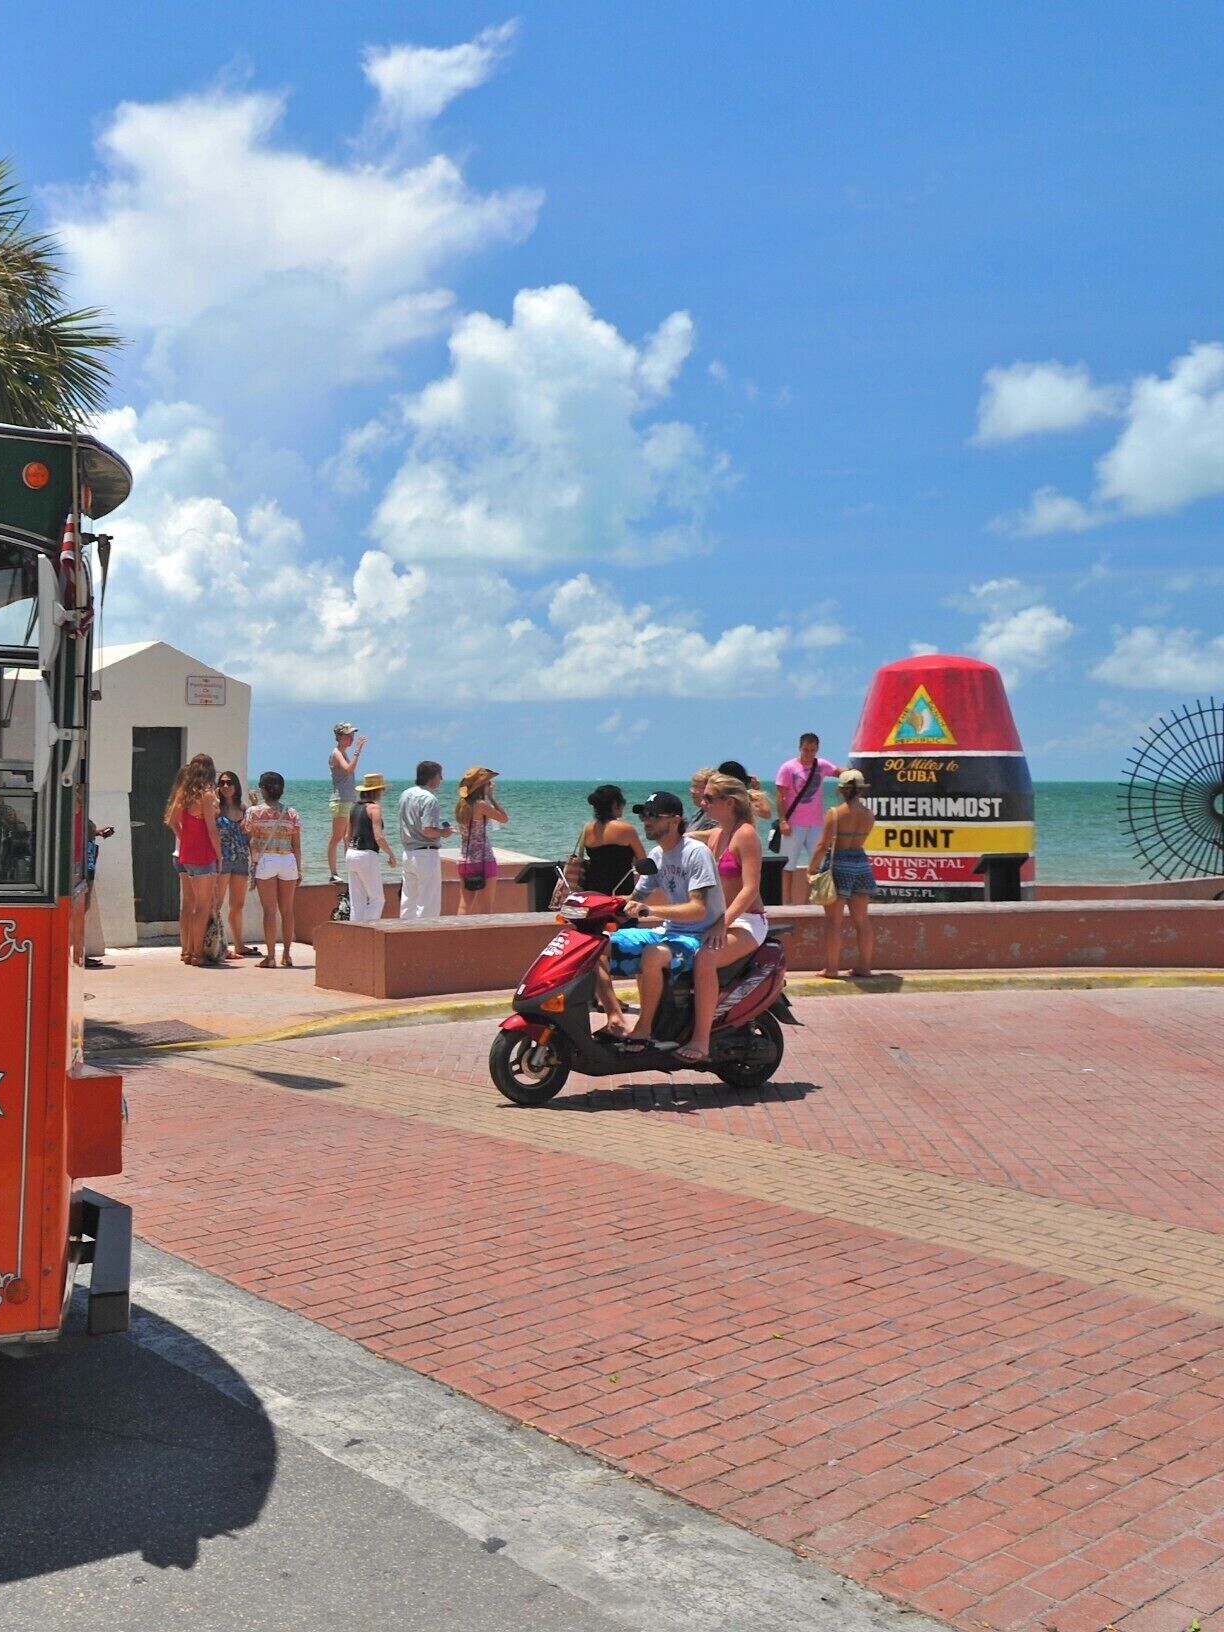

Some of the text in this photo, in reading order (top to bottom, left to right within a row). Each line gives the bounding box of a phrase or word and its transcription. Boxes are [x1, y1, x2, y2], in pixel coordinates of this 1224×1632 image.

[883, 758, 960, 772] 90 Miles to
[896, 770, 937, 782] CUBA
[859, 797, 1003, 818] UTHERNMOST
[884, 829, 954, 848] POINT
[887, 868, 943, 880] U.S.A.
[877, 887, 888, 896] EY
